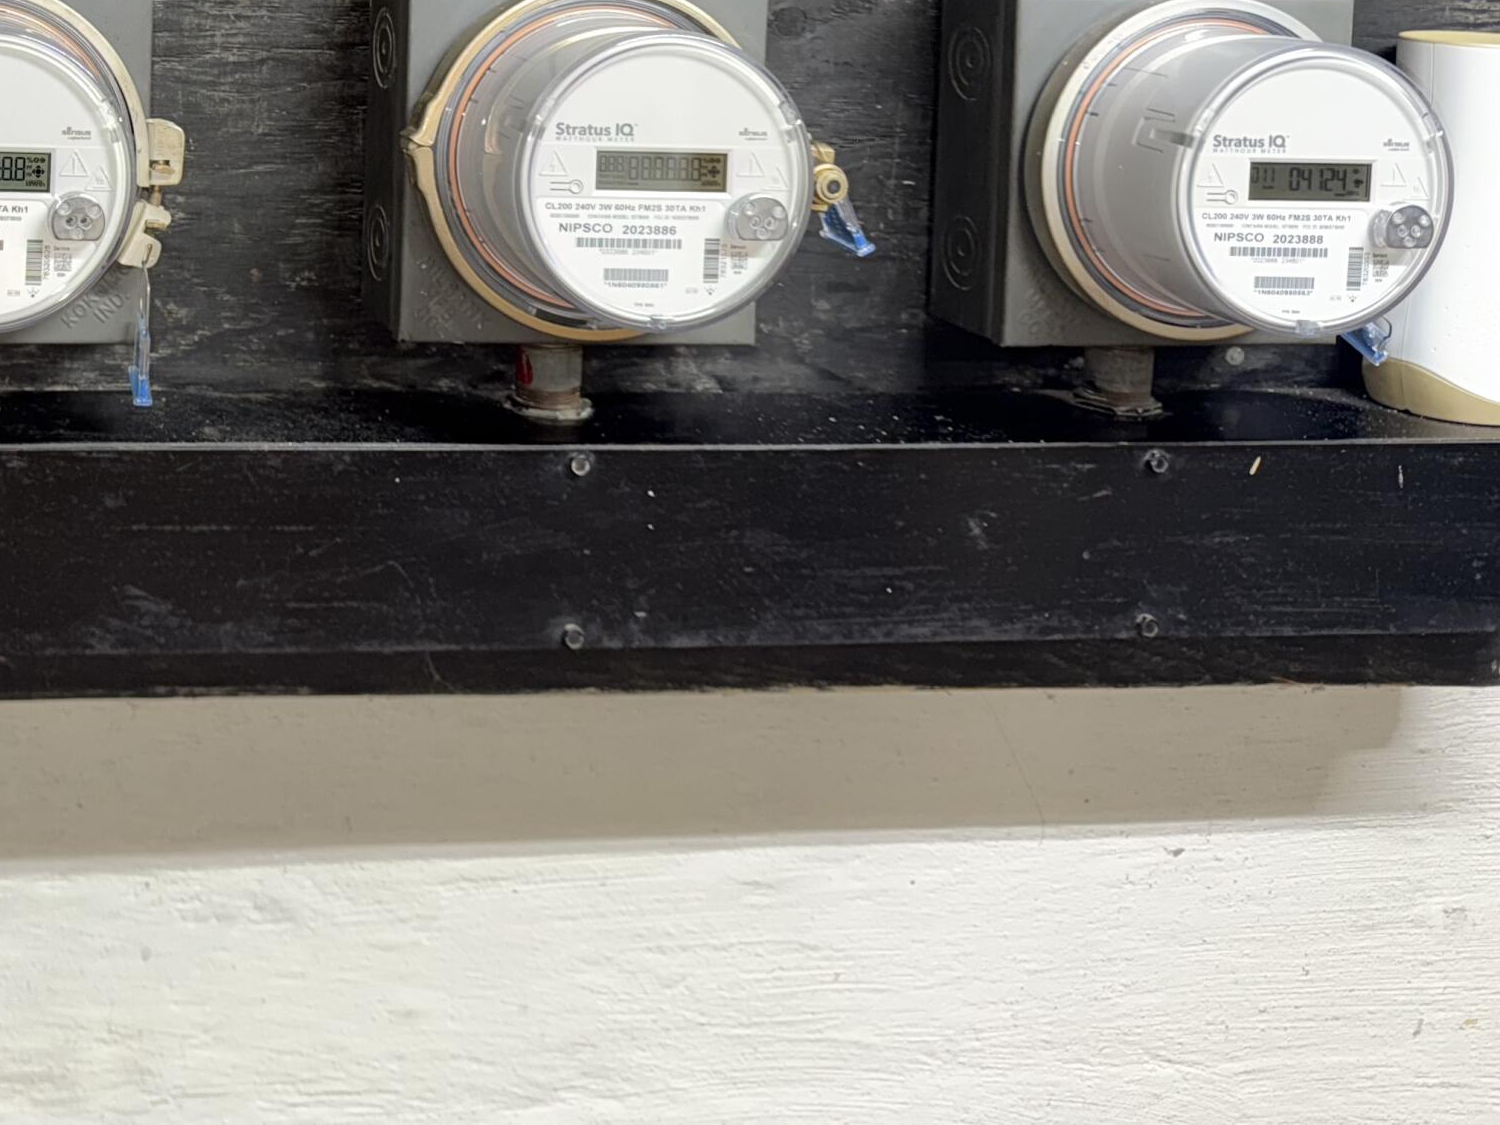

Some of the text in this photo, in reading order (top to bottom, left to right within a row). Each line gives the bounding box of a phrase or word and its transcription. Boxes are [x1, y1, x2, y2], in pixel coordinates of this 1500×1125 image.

[555, 122, 634, 137] Stratus IQ
[1212, 134, 1286, 149] Stratus IQ
[11, 205, 29, 213] Kh1
[545, 202, 573, 210] CL200
[1202, 212, 1227, 220] CL200
[558, 222, 677, 235] NIPSCO 2023886
[1214, 232, 1323, 244] NIPSCO 2023888
